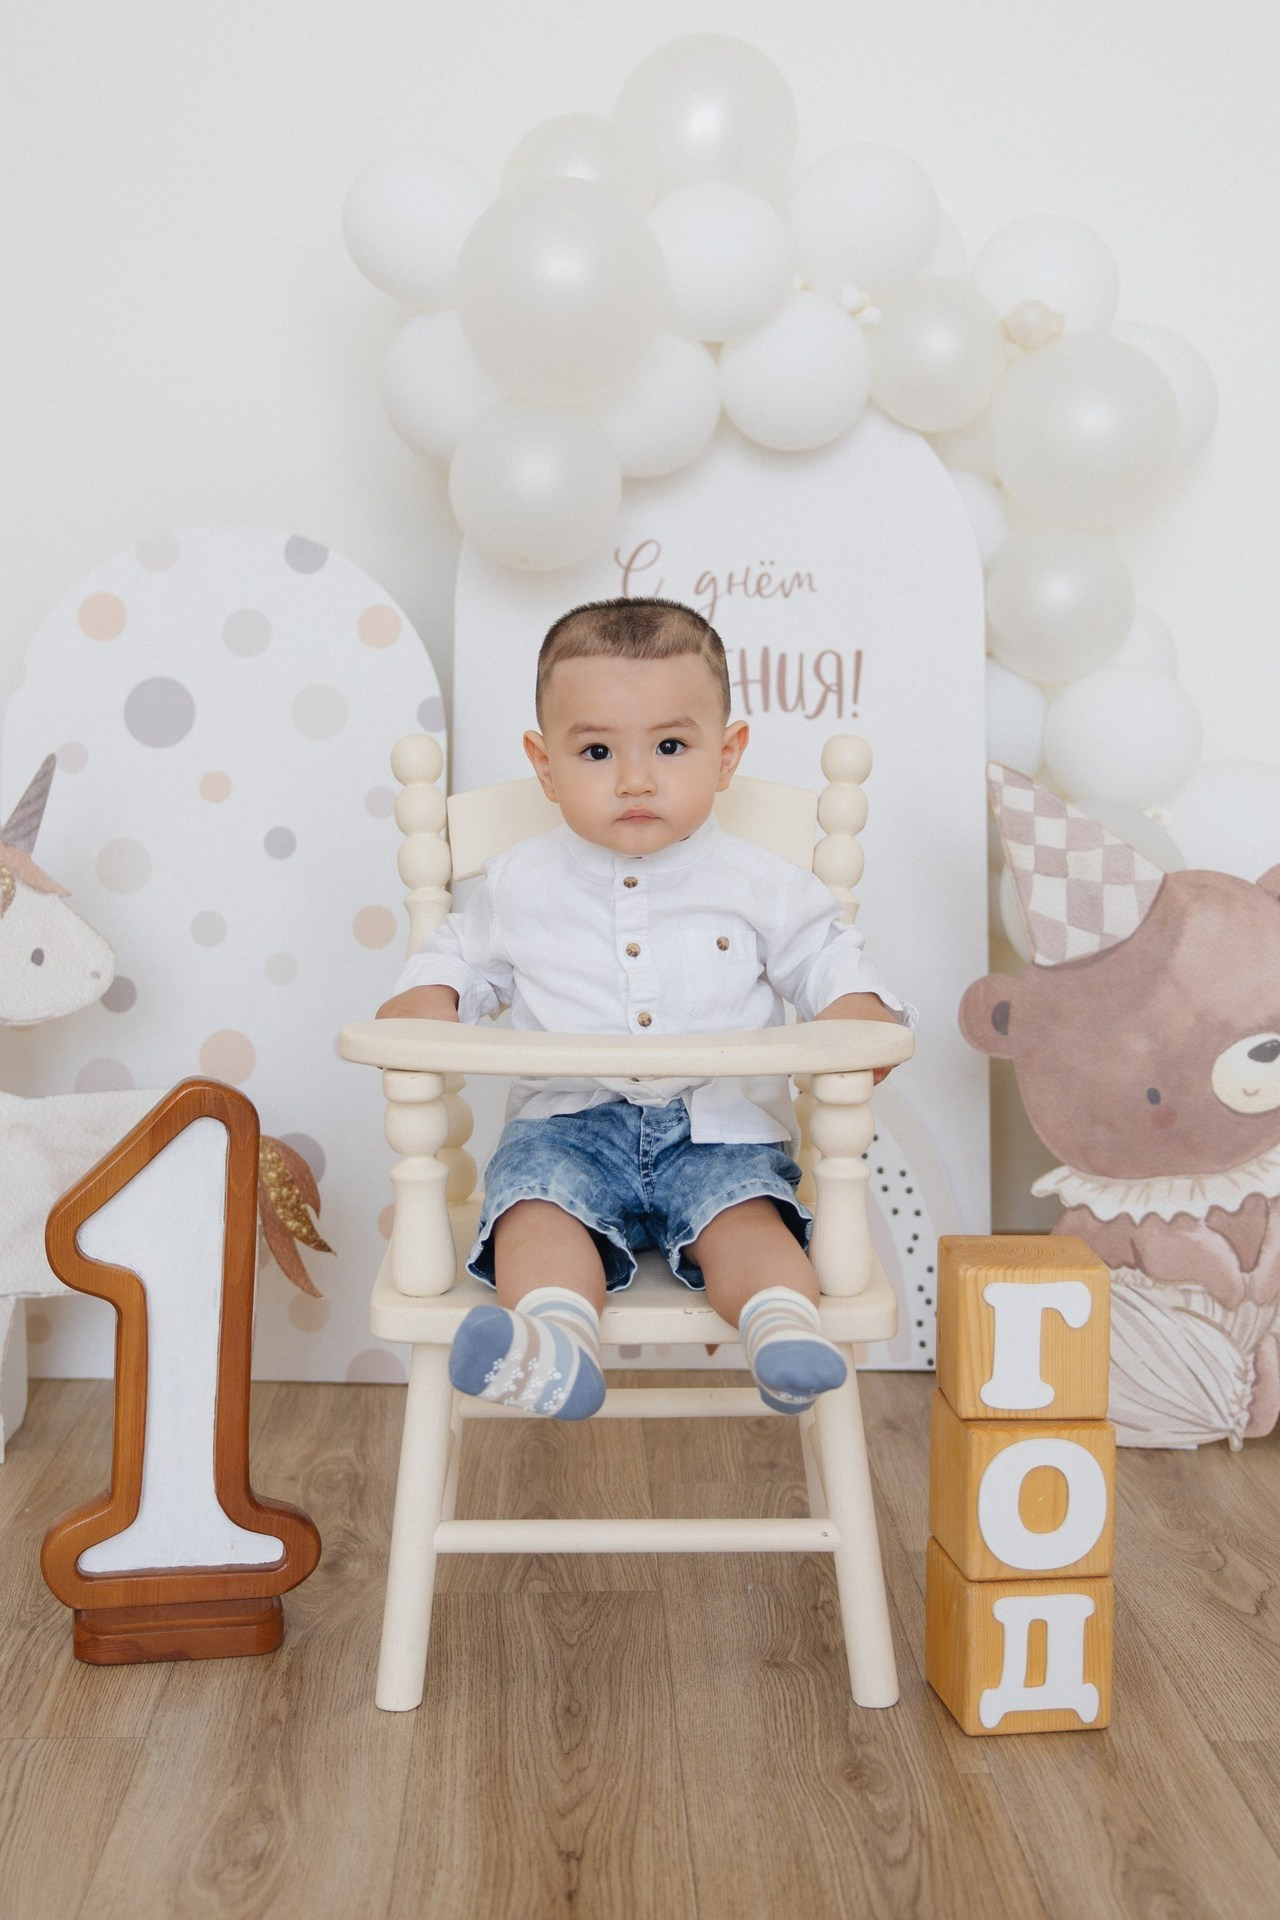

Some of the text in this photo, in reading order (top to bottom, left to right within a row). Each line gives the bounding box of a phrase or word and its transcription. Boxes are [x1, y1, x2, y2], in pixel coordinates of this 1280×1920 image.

[614, 539, 818, 623] С днём
[725, 645, 863, 720] НИЯ!
[41, 1075, 321, 1612] 1
